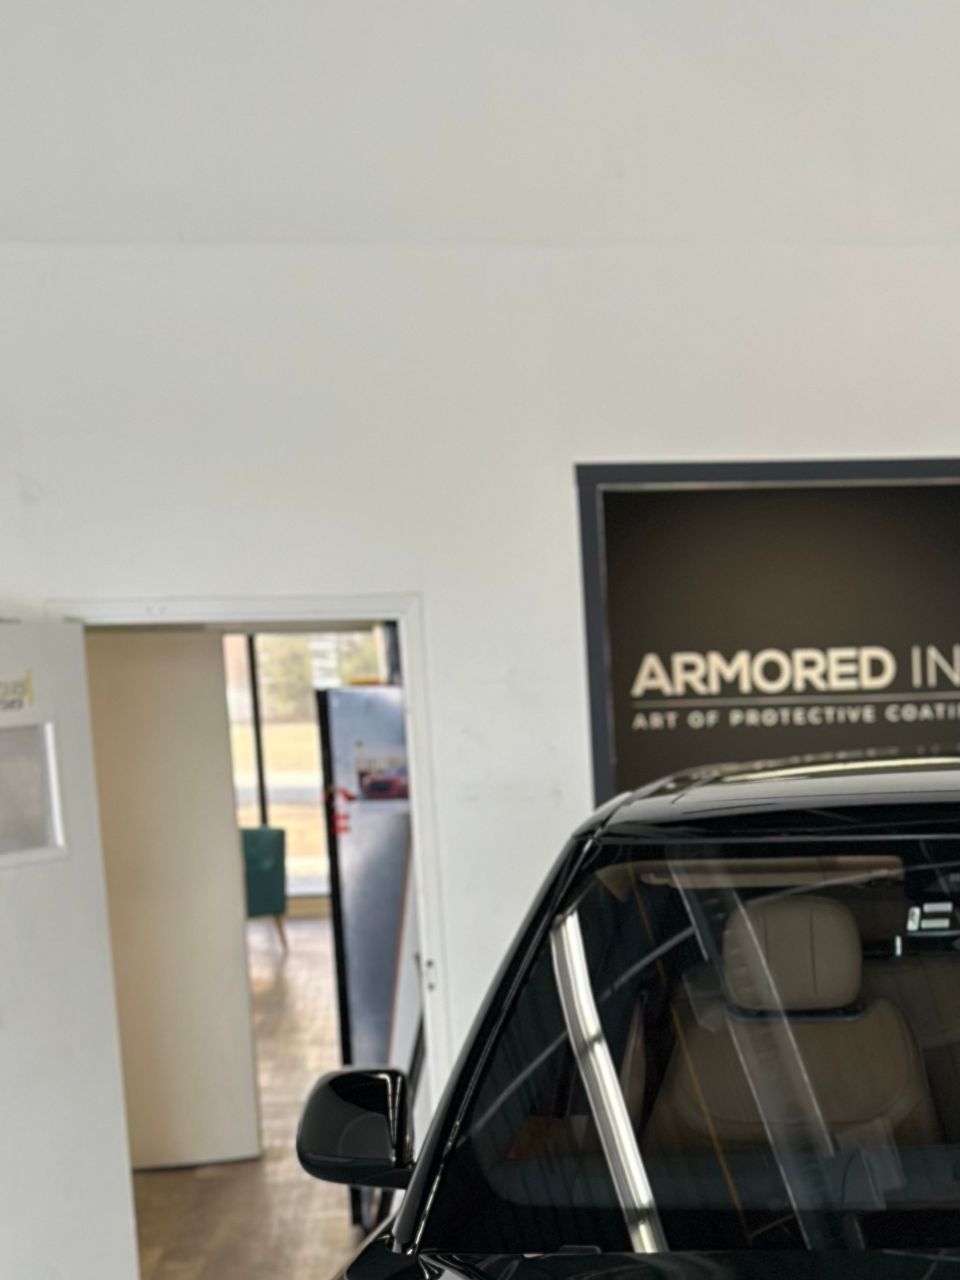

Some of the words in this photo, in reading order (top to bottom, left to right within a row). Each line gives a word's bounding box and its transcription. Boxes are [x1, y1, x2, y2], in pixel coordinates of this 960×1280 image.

[630, 646, 897, 698] ARMORED
[632, 711, 678, 731] ART
[687, 710, 719, 730] OF
[729, 704, 877, 728] PROTECTIVE
